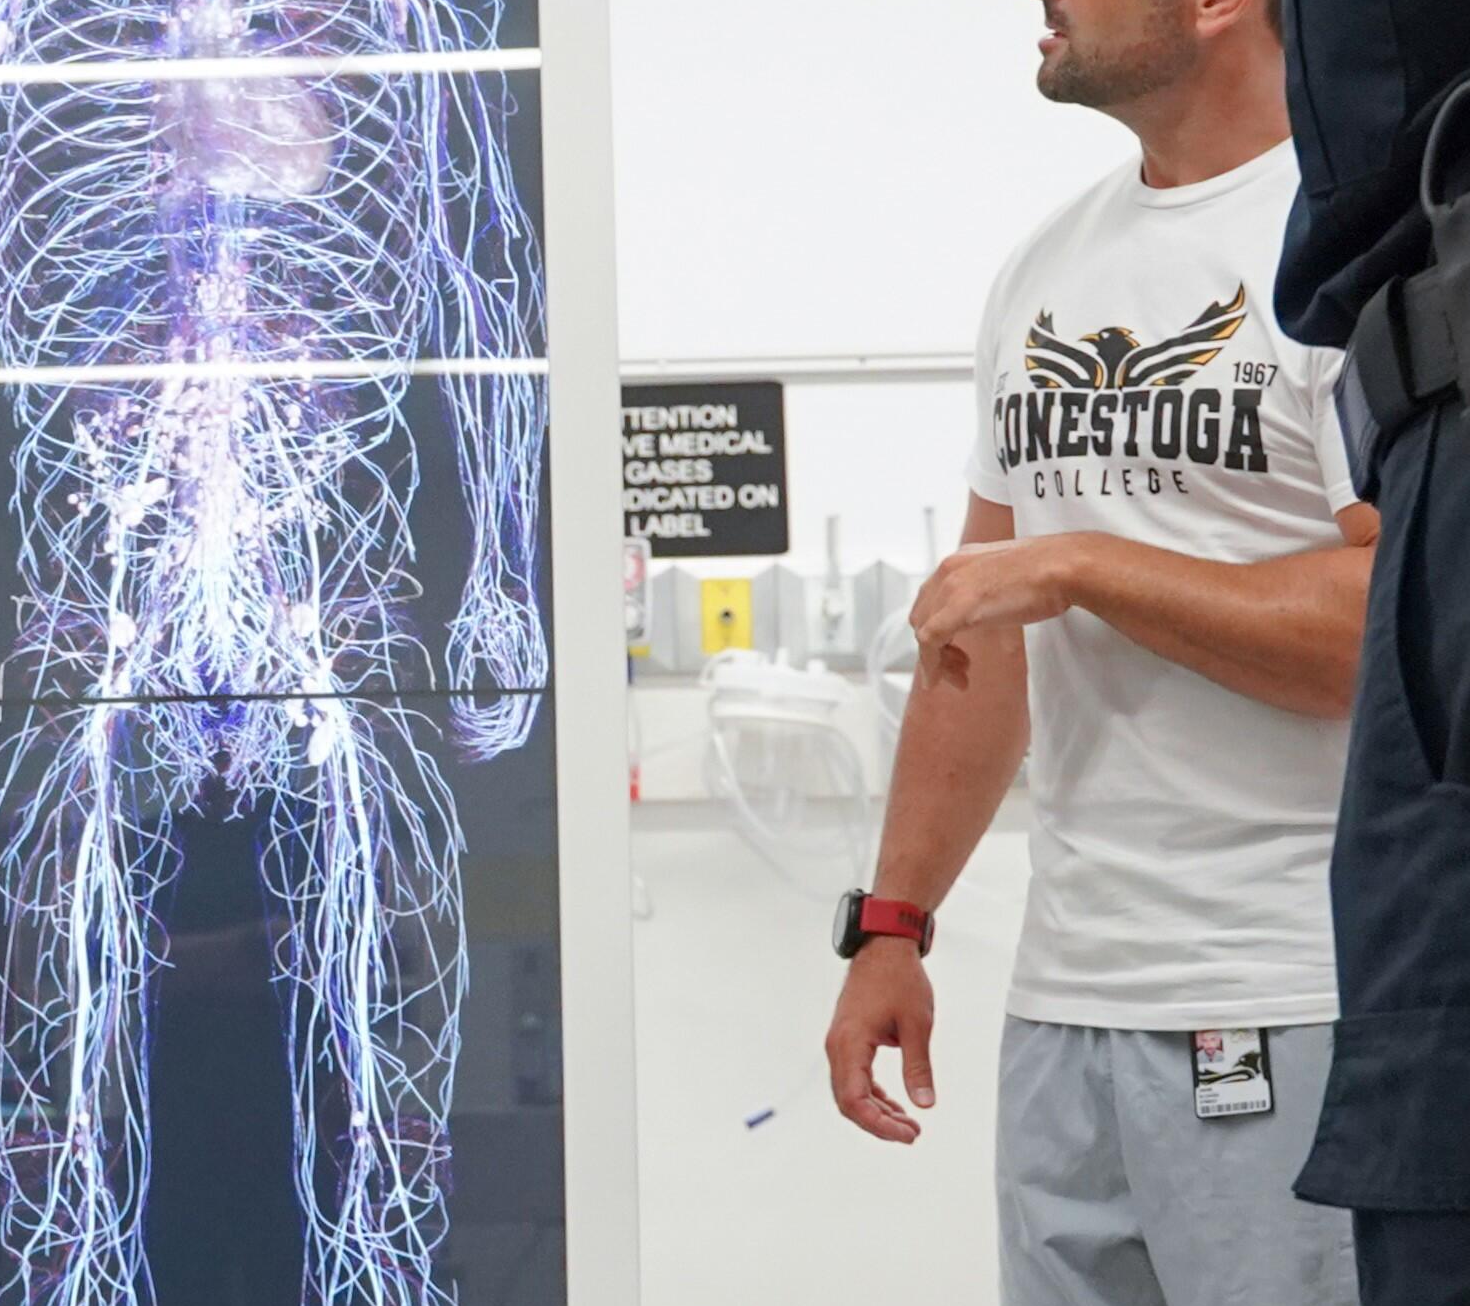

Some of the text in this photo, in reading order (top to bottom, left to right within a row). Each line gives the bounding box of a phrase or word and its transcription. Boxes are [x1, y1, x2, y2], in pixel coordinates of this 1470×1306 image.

[1232, 361, 1279, 387] 1967
[622, 429, 774, 458] VE MEDICAL
[993, 388, 1269, 475] CONESTOGA
[624, 458, 714, 485] GASES
[1034, 467, 1188, 498] COLLEGE
[622, 483, 780, 512] DICATED ON
[629, 512, 712, 538] LABEL
